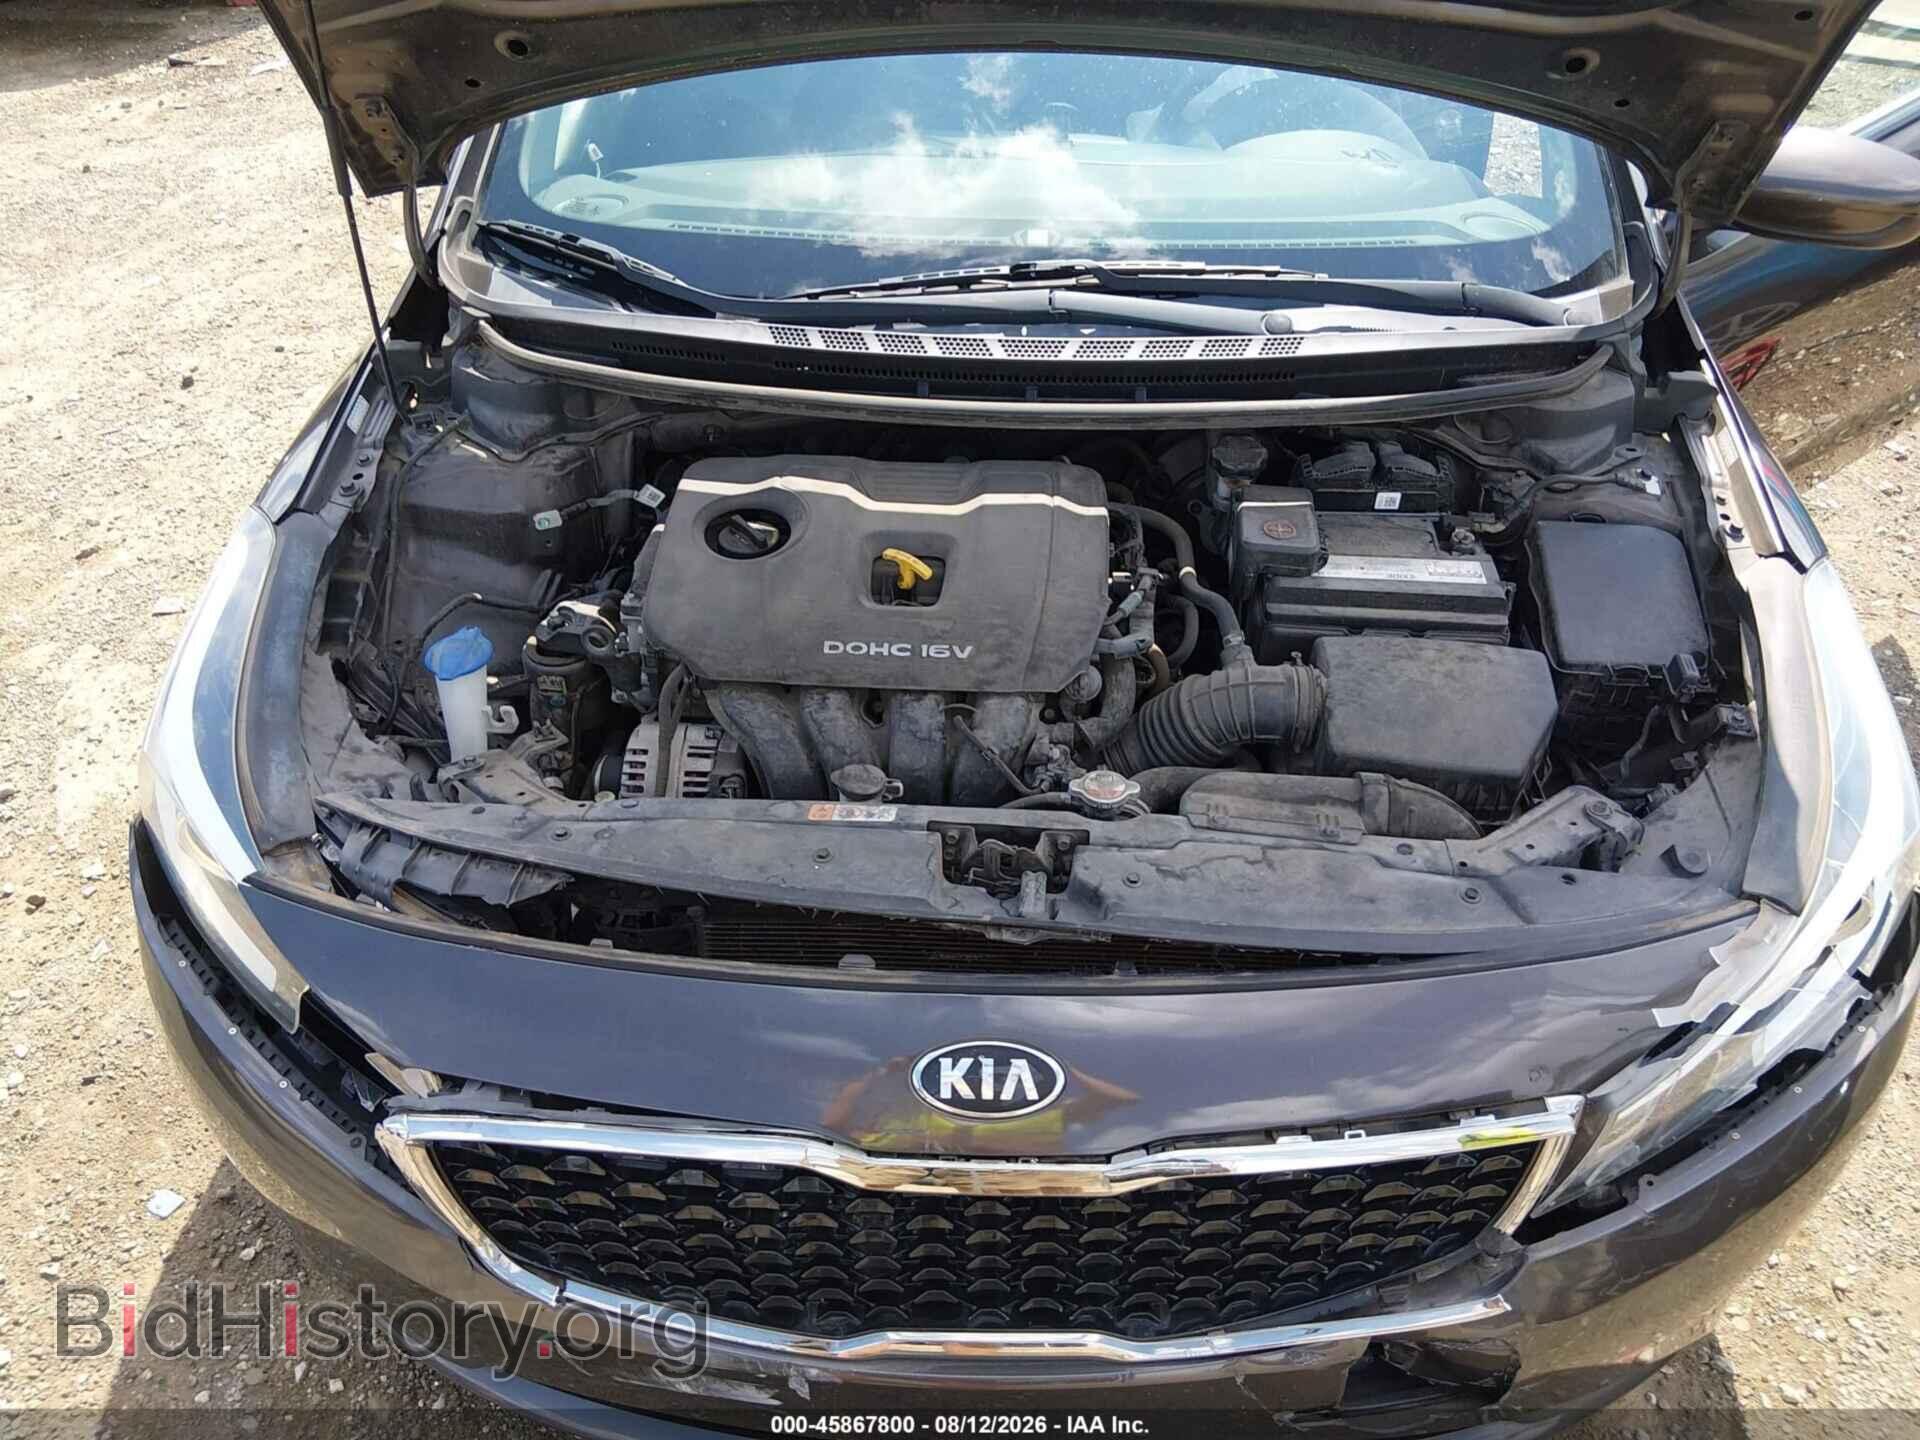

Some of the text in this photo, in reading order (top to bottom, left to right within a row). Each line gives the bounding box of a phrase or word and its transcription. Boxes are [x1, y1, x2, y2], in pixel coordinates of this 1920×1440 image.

[823, 640, 974, 659] DOHC 16V
[938, 1054, 1040, 1101] KIA
